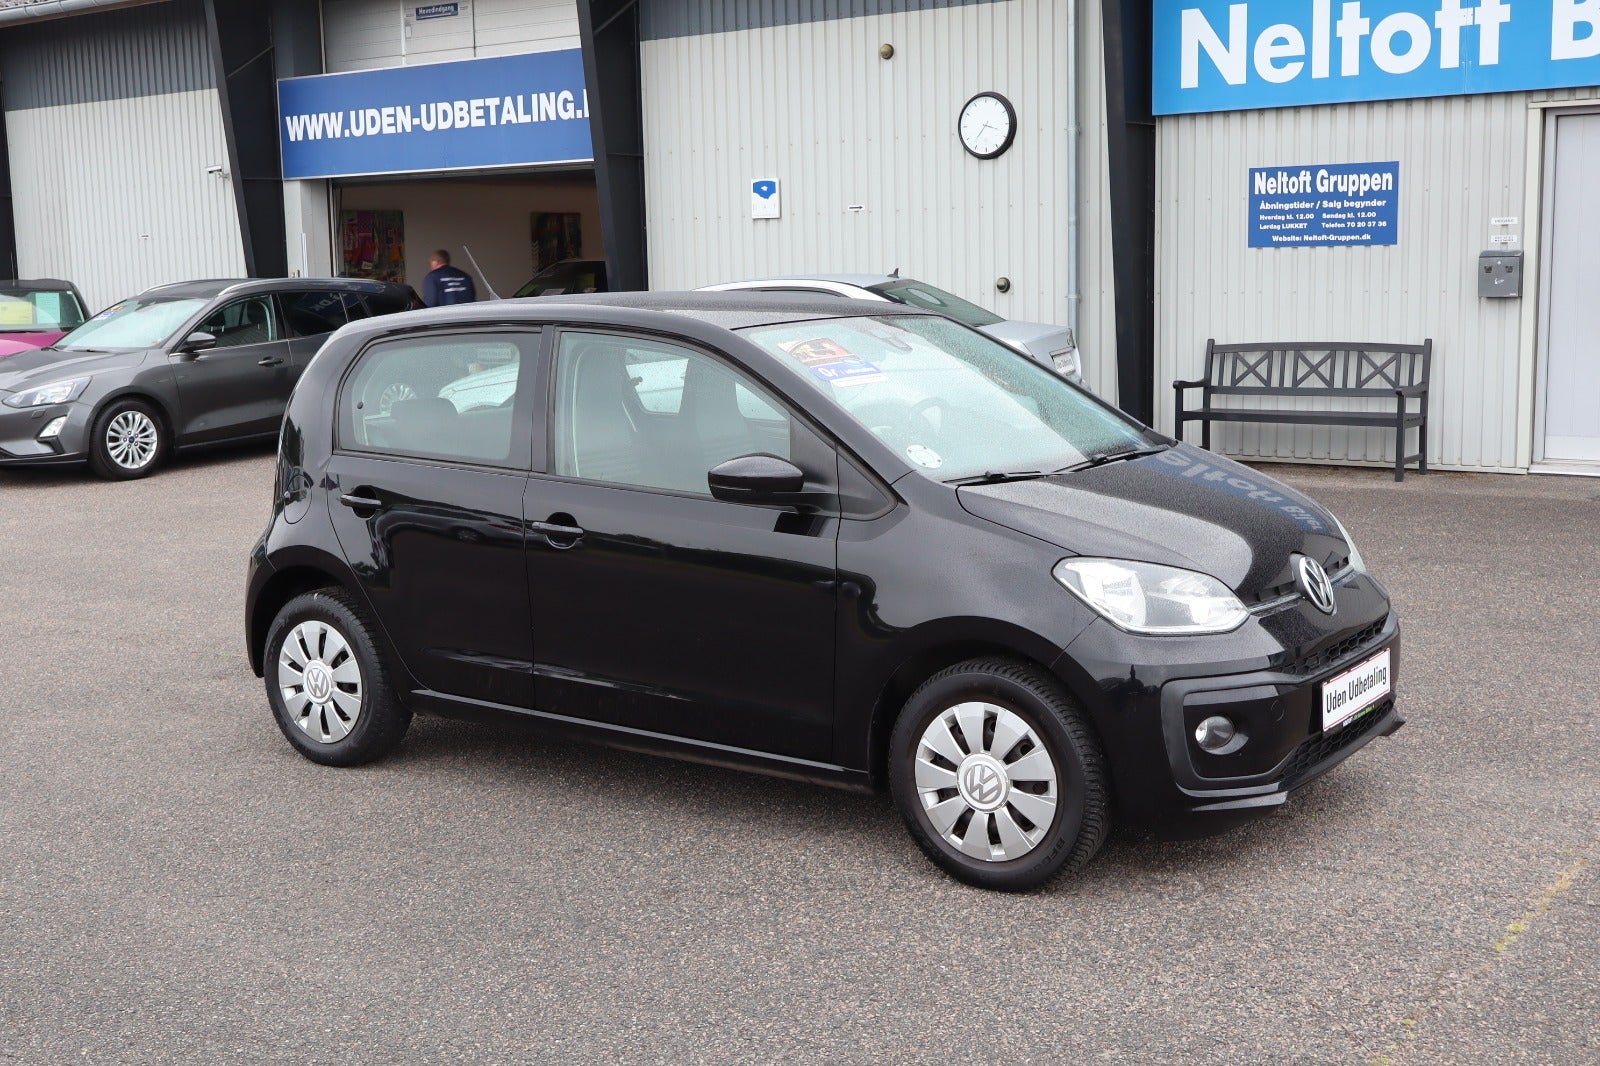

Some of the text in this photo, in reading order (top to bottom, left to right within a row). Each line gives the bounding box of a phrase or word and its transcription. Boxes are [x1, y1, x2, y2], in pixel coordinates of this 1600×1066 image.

[1180, 0, 1511, 89] Neltoft
[285, 88, 590, 142] WWW.UDEN-UDBETALING.
[1254, 169, 1393, 196] Neltoft Gruppen
[1259, 200, 1315, 211] Åbningstider
[1322, 200, 1342, 209] Salg
[1343, 198, 1387, 209] begynder
[1272, 233, 1372, 242] Website: Neltoft-Gruppen.dk
[1326, 665, 1387, 714] Uden Udbetaling
